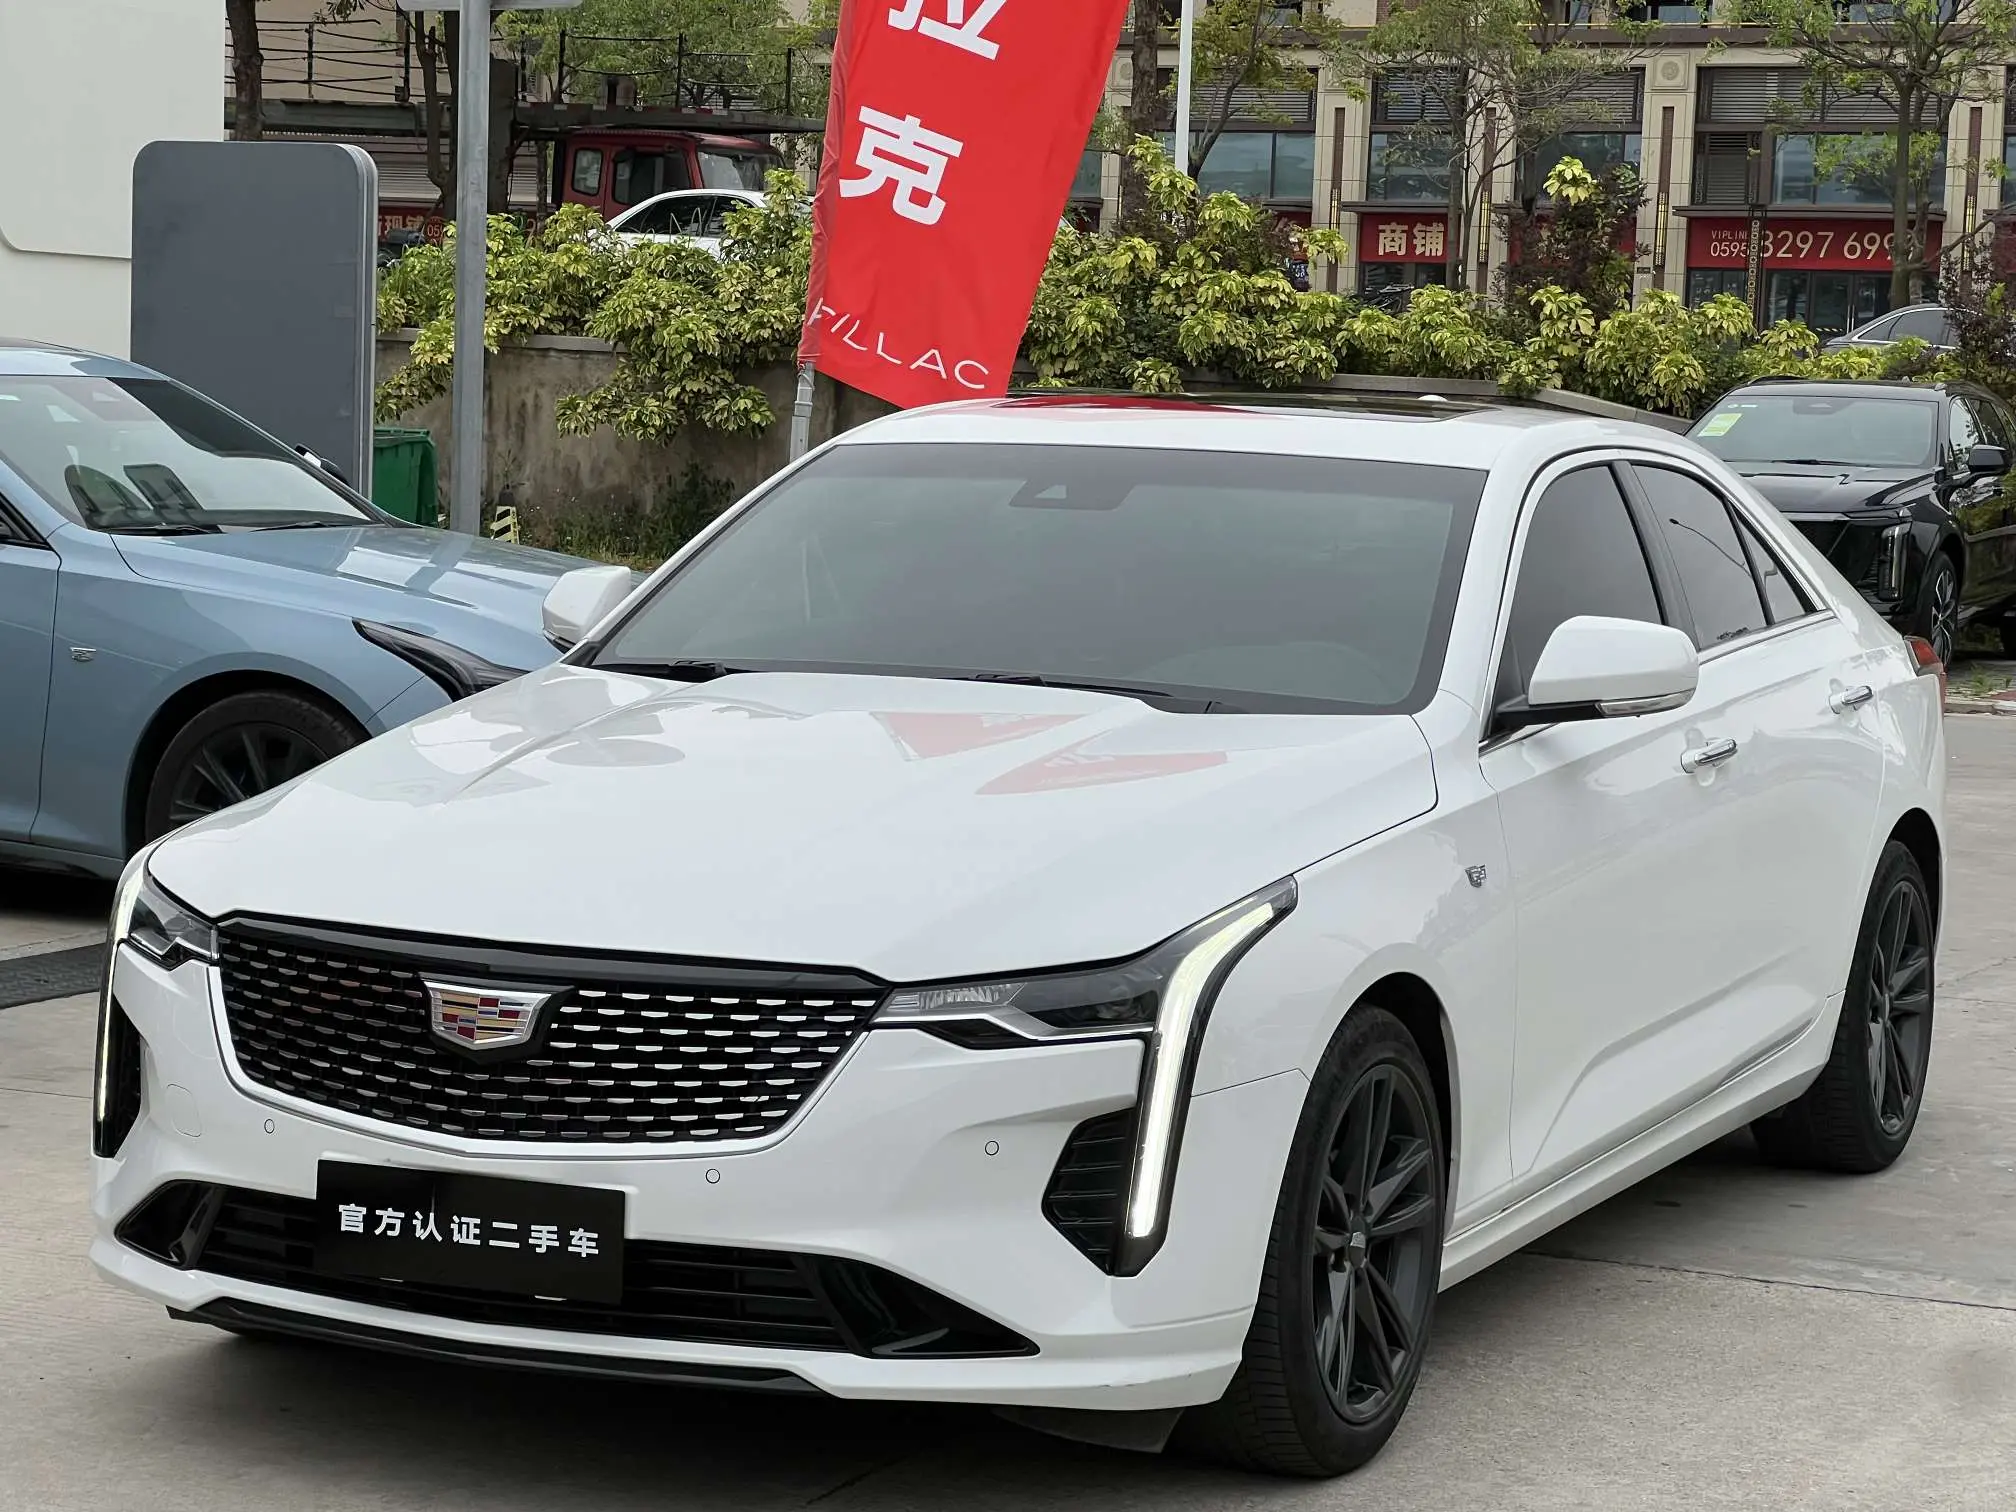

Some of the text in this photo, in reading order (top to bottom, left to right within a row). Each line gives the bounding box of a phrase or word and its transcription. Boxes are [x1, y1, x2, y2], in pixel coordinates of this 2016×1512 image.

[1377, 222, 1445, 257] 商铺
[1710, 241, 1750, 257] 0595
[338, 1203, 600, 1258] 官方认证二手车
